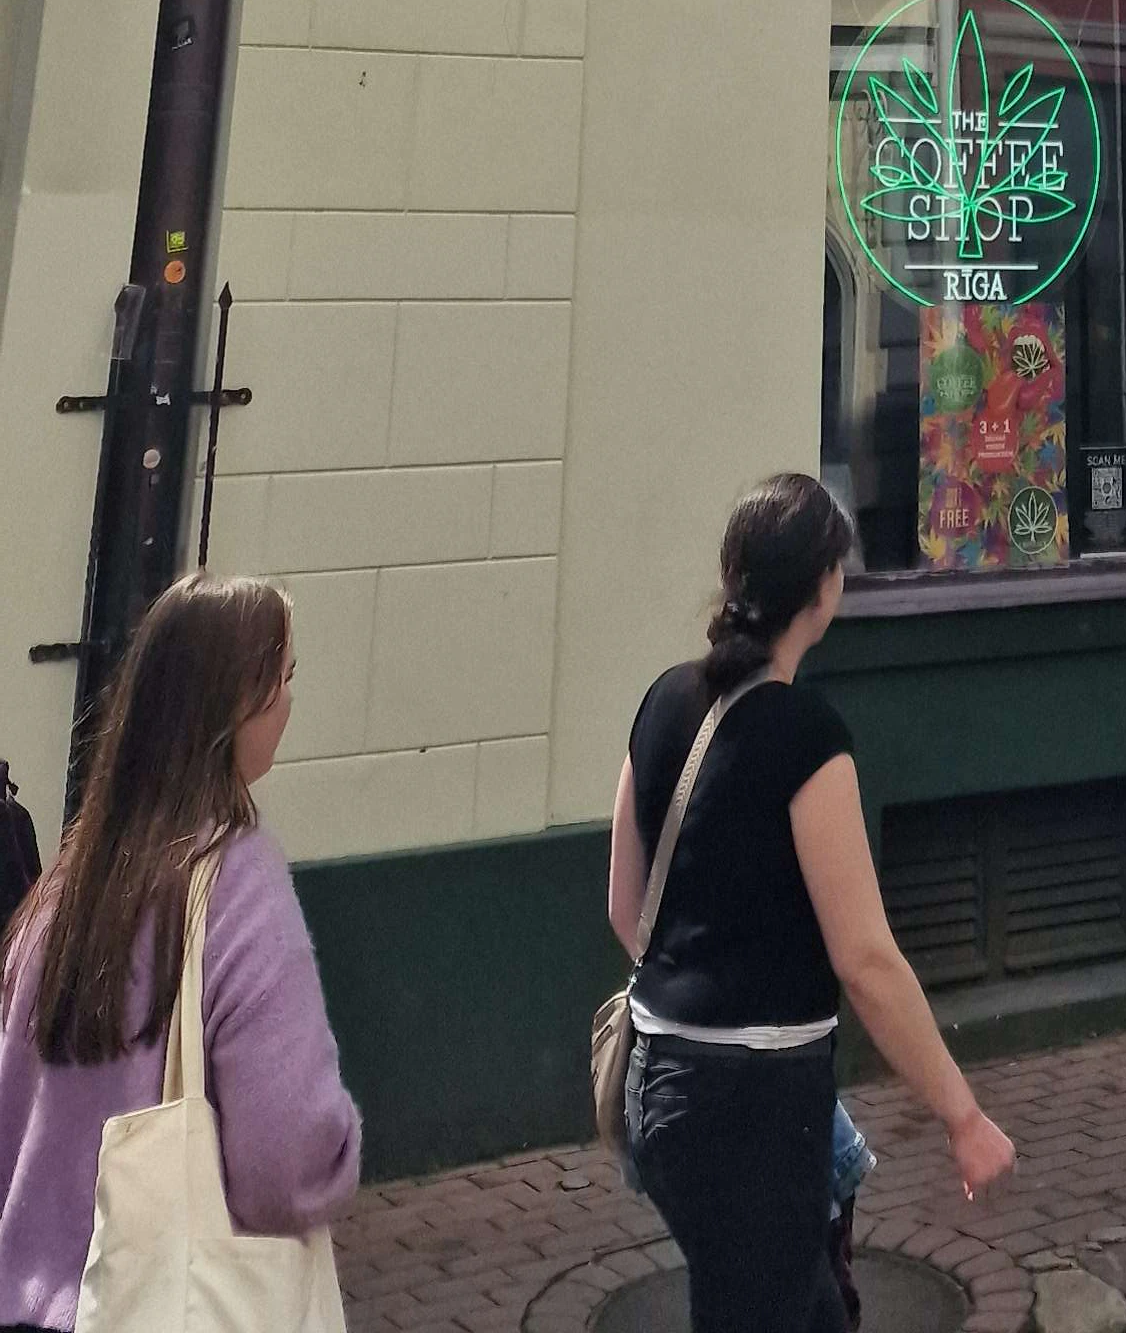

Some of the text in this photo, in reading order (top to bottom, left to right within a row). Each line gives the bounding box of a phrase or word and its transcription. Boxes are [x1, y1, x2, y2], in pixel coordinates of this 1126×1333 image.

[953, 111, 988, 132] THE
[875, 137, 1067, 191] COFFEE
[907, 195, 1034, 242] SHOP
[979, 420, 988, 434] 3
[1003, 418, 1011, 433] 1
[1087, 454, 1126, 466] SCAN ME
[940, 509, 970, 529] FREE
